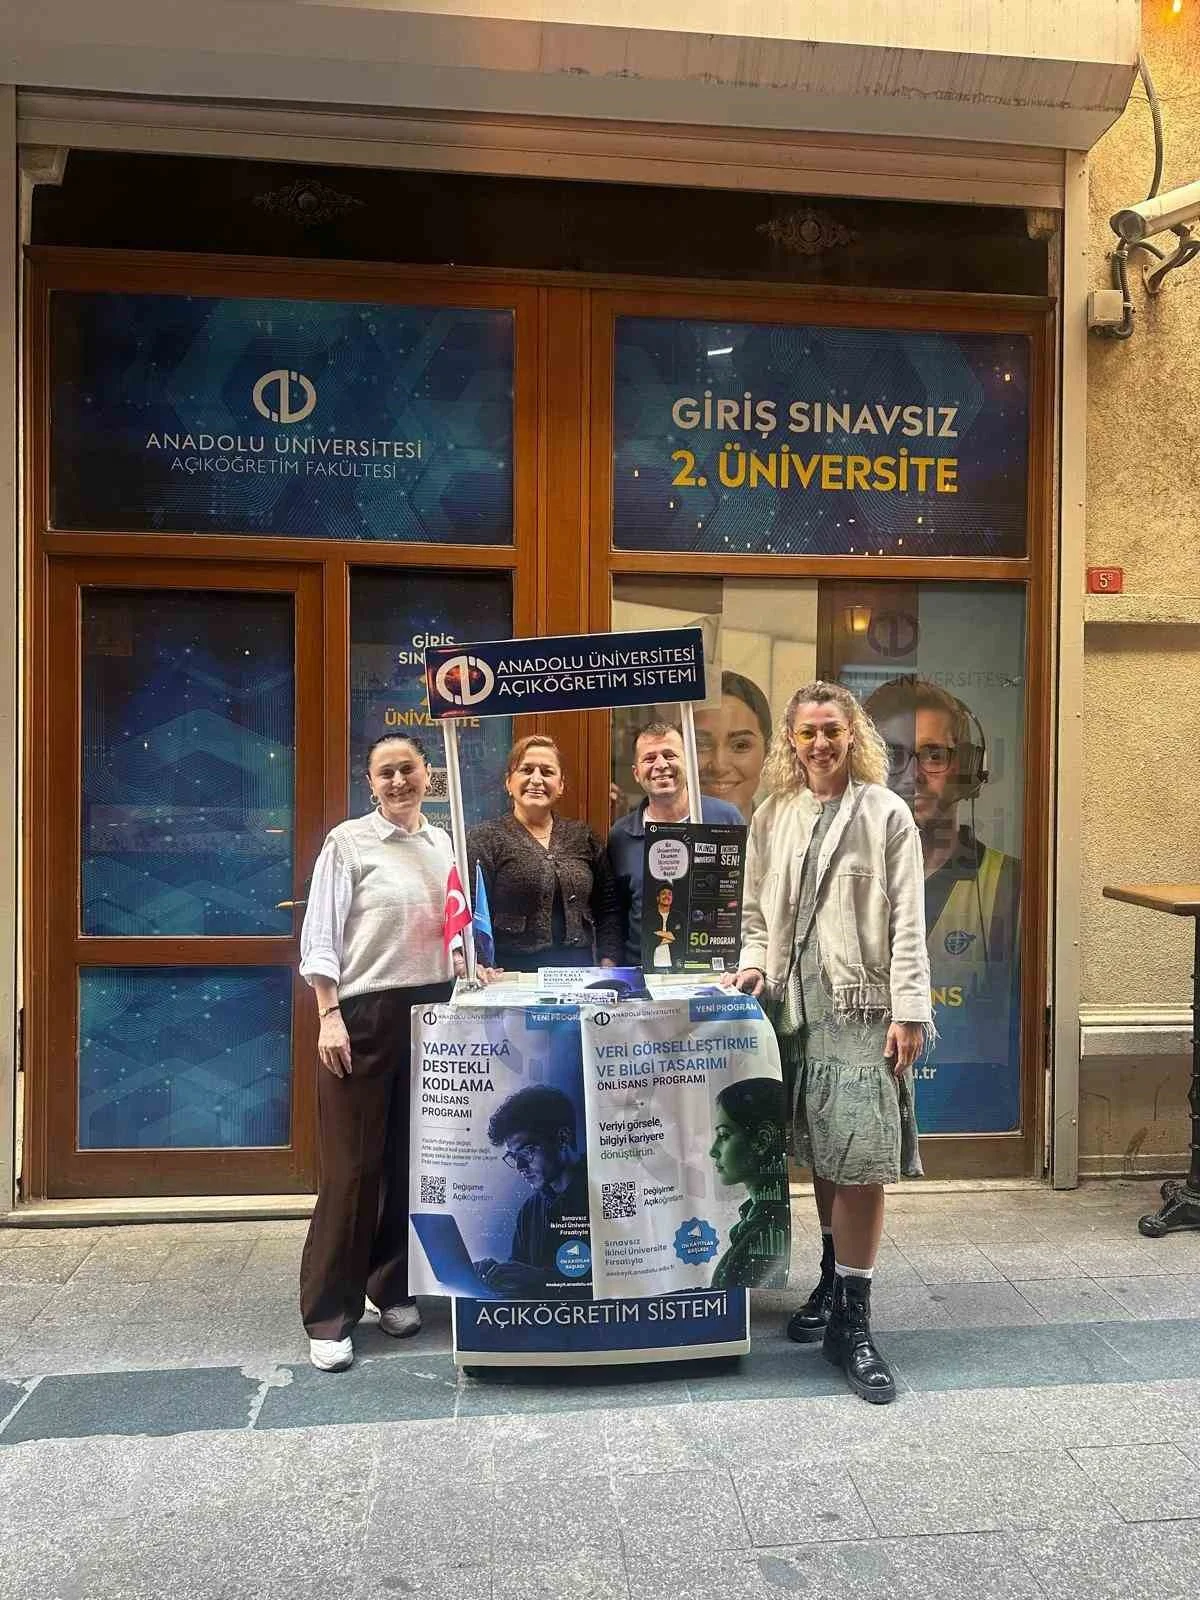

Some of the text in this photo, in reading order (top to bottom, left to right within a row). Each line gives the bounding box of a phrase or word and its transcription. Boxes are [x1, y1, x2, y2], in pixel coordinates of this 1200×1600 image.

[672, 390, 958, 439] GİRİŞ SINAVSIZ
[146, 433, 422, 459] ANADOLU ÜNİVERSİTESİ
[171, 455, 397, 479] AÇIKÖĞRETİM FAKÜLTESİ
[671, 442, 958, 493] 2. ÜNİVERSİTE
[497, 645, 695, 674] ANADOLU ÜNİVERSİTESİ
[499, 666, 697, 697] AÇIKÖĞRETİM SİSTEMİ
[721, 854, 740, 866] SEN!
[690, 932, 736, 946] 50 PROGRAM
[696, 1002, 758, 1013] YENİ PROGRAM
[423, 1039, 510, 1056] YAPAY ZEKÂ
[595, 1036, 758, 1058] VERİ GÖRSELLEŞTİRME
[423, 1059, 490, 1074] DESTEKLİ
[597, 1057, 727, 1077] VE BİLGİ TASARIMI
[422, 1077, 495, 1092] KODLAMA
[653, 1074, 706, 1087] PROGRAMI
[422, 1106, 472, 1118] PROGRAMI
[599, 1116, 662, 1132] Veriyi görsele,
[600, 1132, 664, 1146] bilgiyi kariyere
[600, 1147, 656, 1160] dönüştürün.
[476, 1295, 727, 1329] AÇIKÖĞRETİM SİSTEMİ
